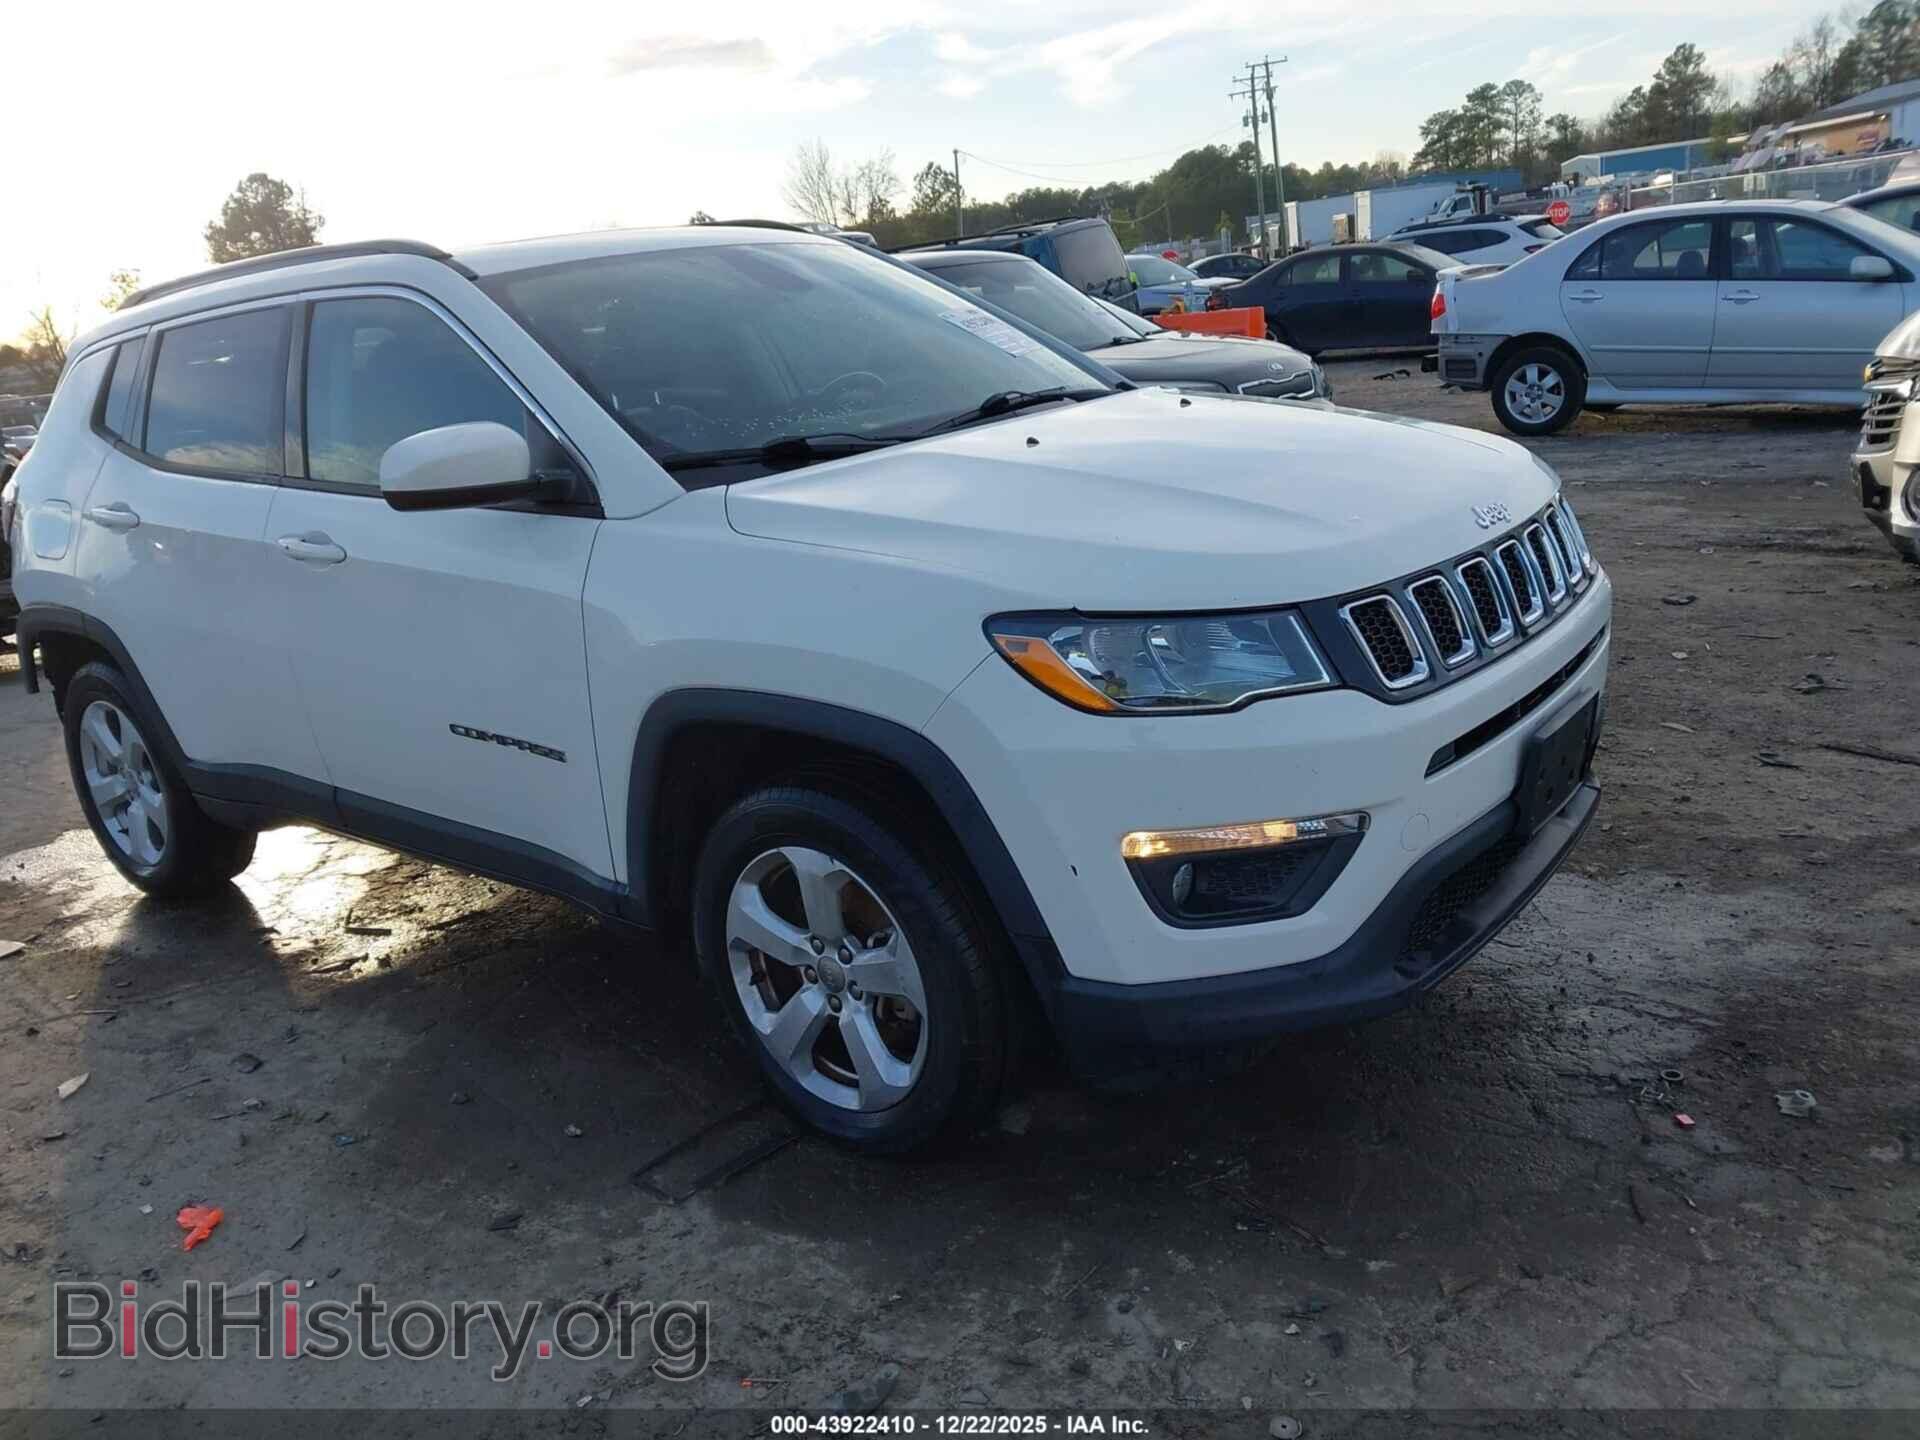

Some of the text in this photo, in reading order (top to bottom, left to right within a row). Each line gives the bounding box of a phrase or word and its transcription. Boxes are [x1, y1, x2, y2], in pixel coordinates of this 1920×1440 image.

[1549, 206, 1569, 217] STOP
[1471, 503, 1512, 529] Jeep
[449, 723, 567, 763] COMPASS
